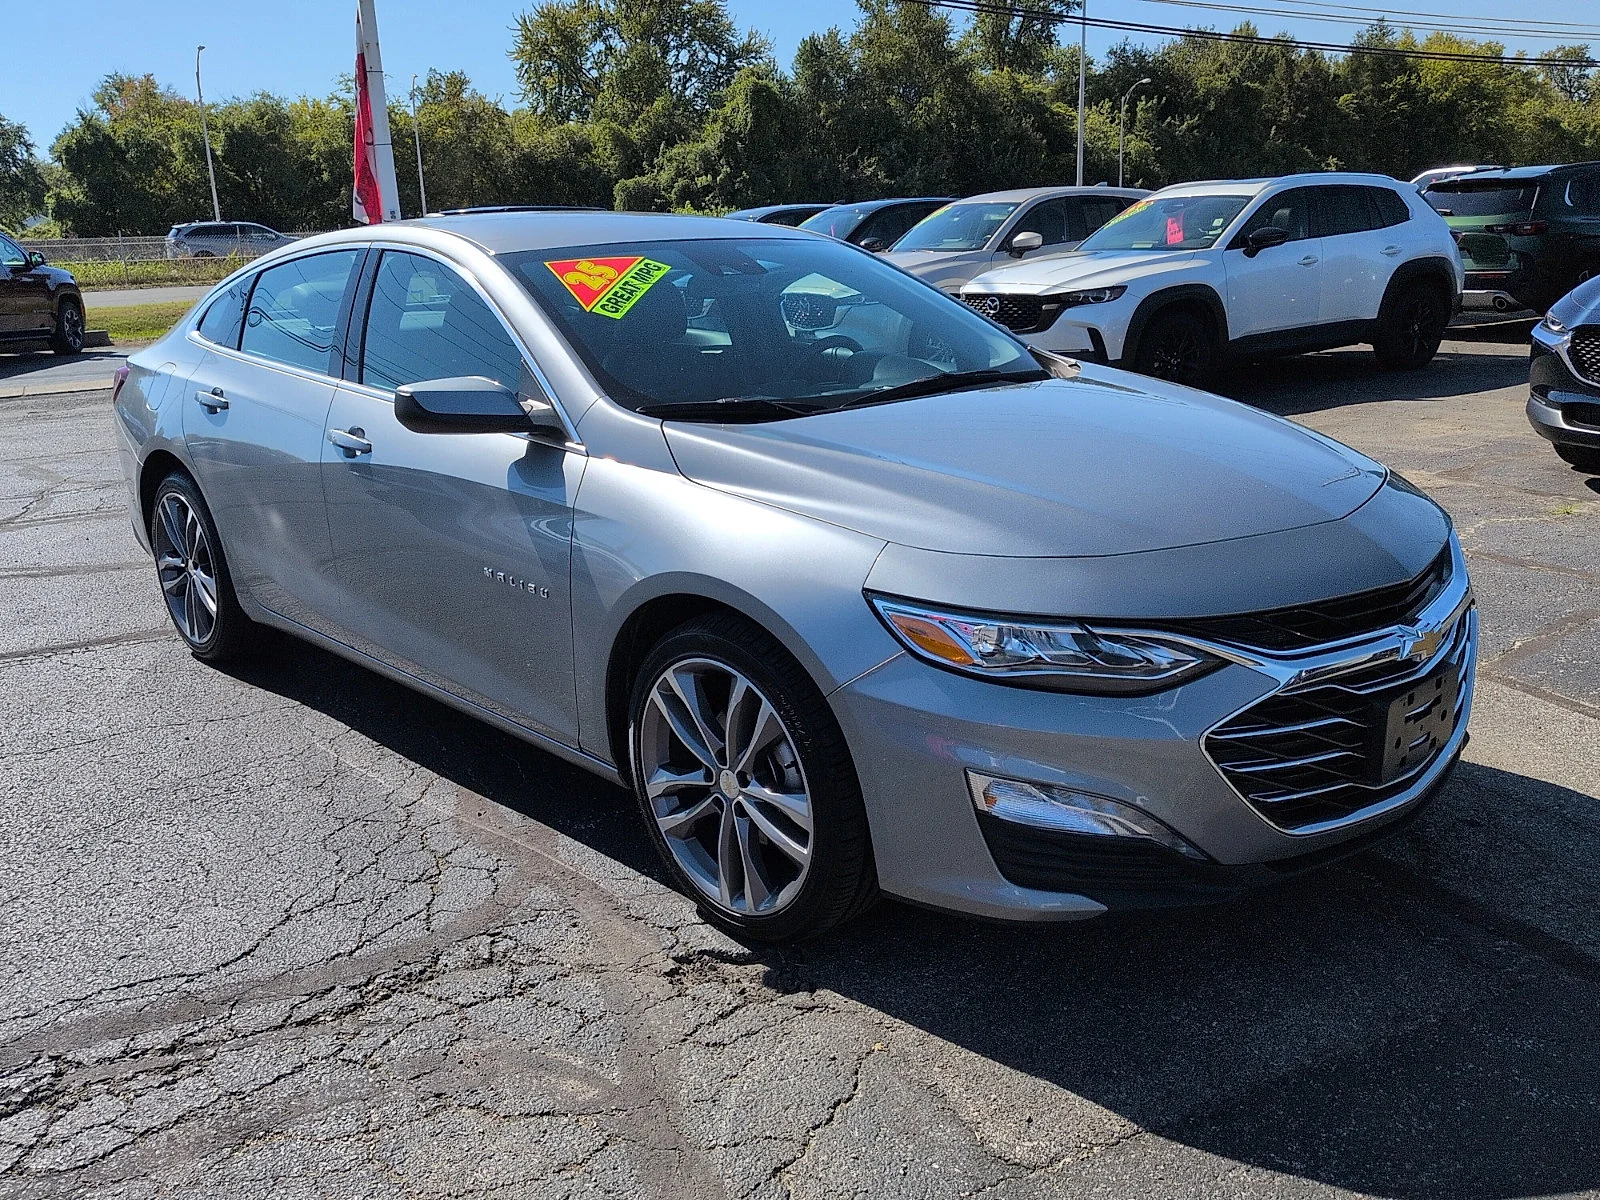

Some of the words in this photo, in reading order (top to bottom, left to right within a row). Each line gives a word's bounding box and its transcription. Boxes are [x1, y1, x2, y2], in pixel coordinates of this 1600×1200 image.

[563, 260, 619, 291] 25
[600, 281, 641, 314] GREAT
[630, 262, 662, 284] MPG
[483, 567, 549, 598] MALIBU
